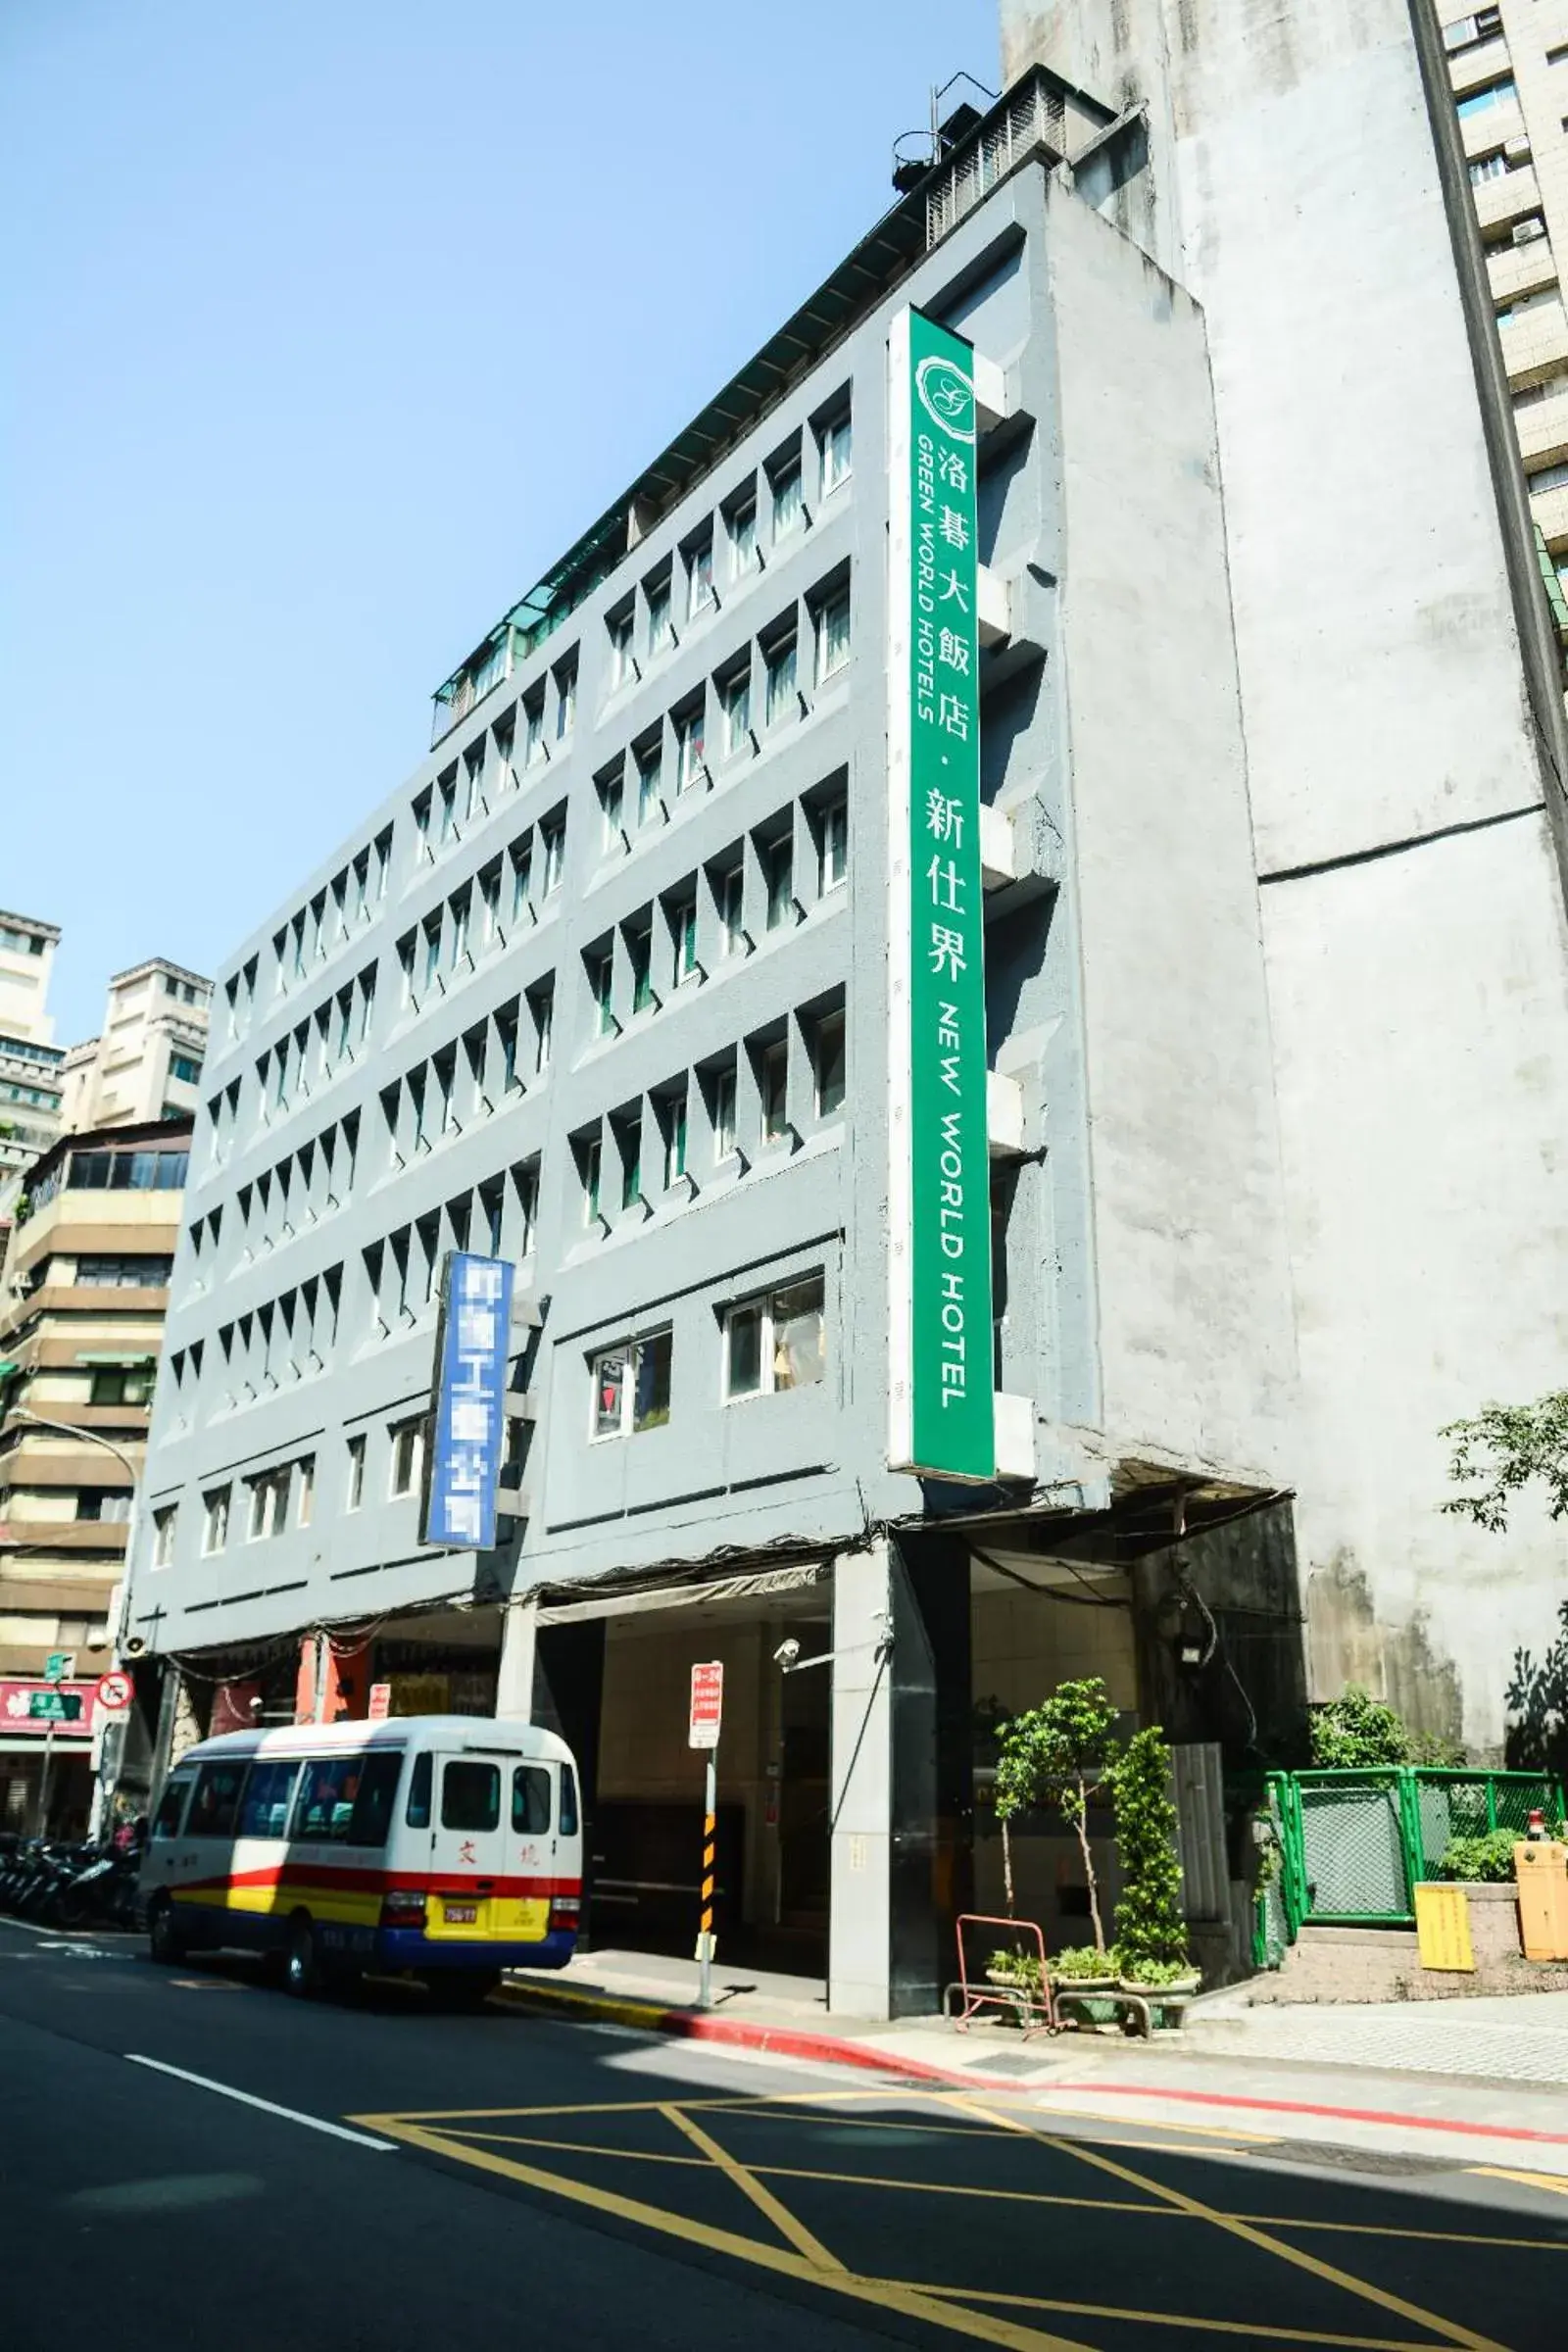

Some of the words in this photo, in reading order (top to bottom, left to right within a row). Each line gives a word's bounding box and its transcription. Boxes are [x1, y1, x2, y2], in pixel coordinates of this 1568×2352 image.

[917, 434, 935, 514] GREEN
[917, 523, 935, 612] WORLD
[917, 617, 935, 724] HOTELS
[938, 1001, 961, 1096] NEW
[940, 1112, 964, 1258] WORLD
[942, 1272, 965, 1409] HOTEL
